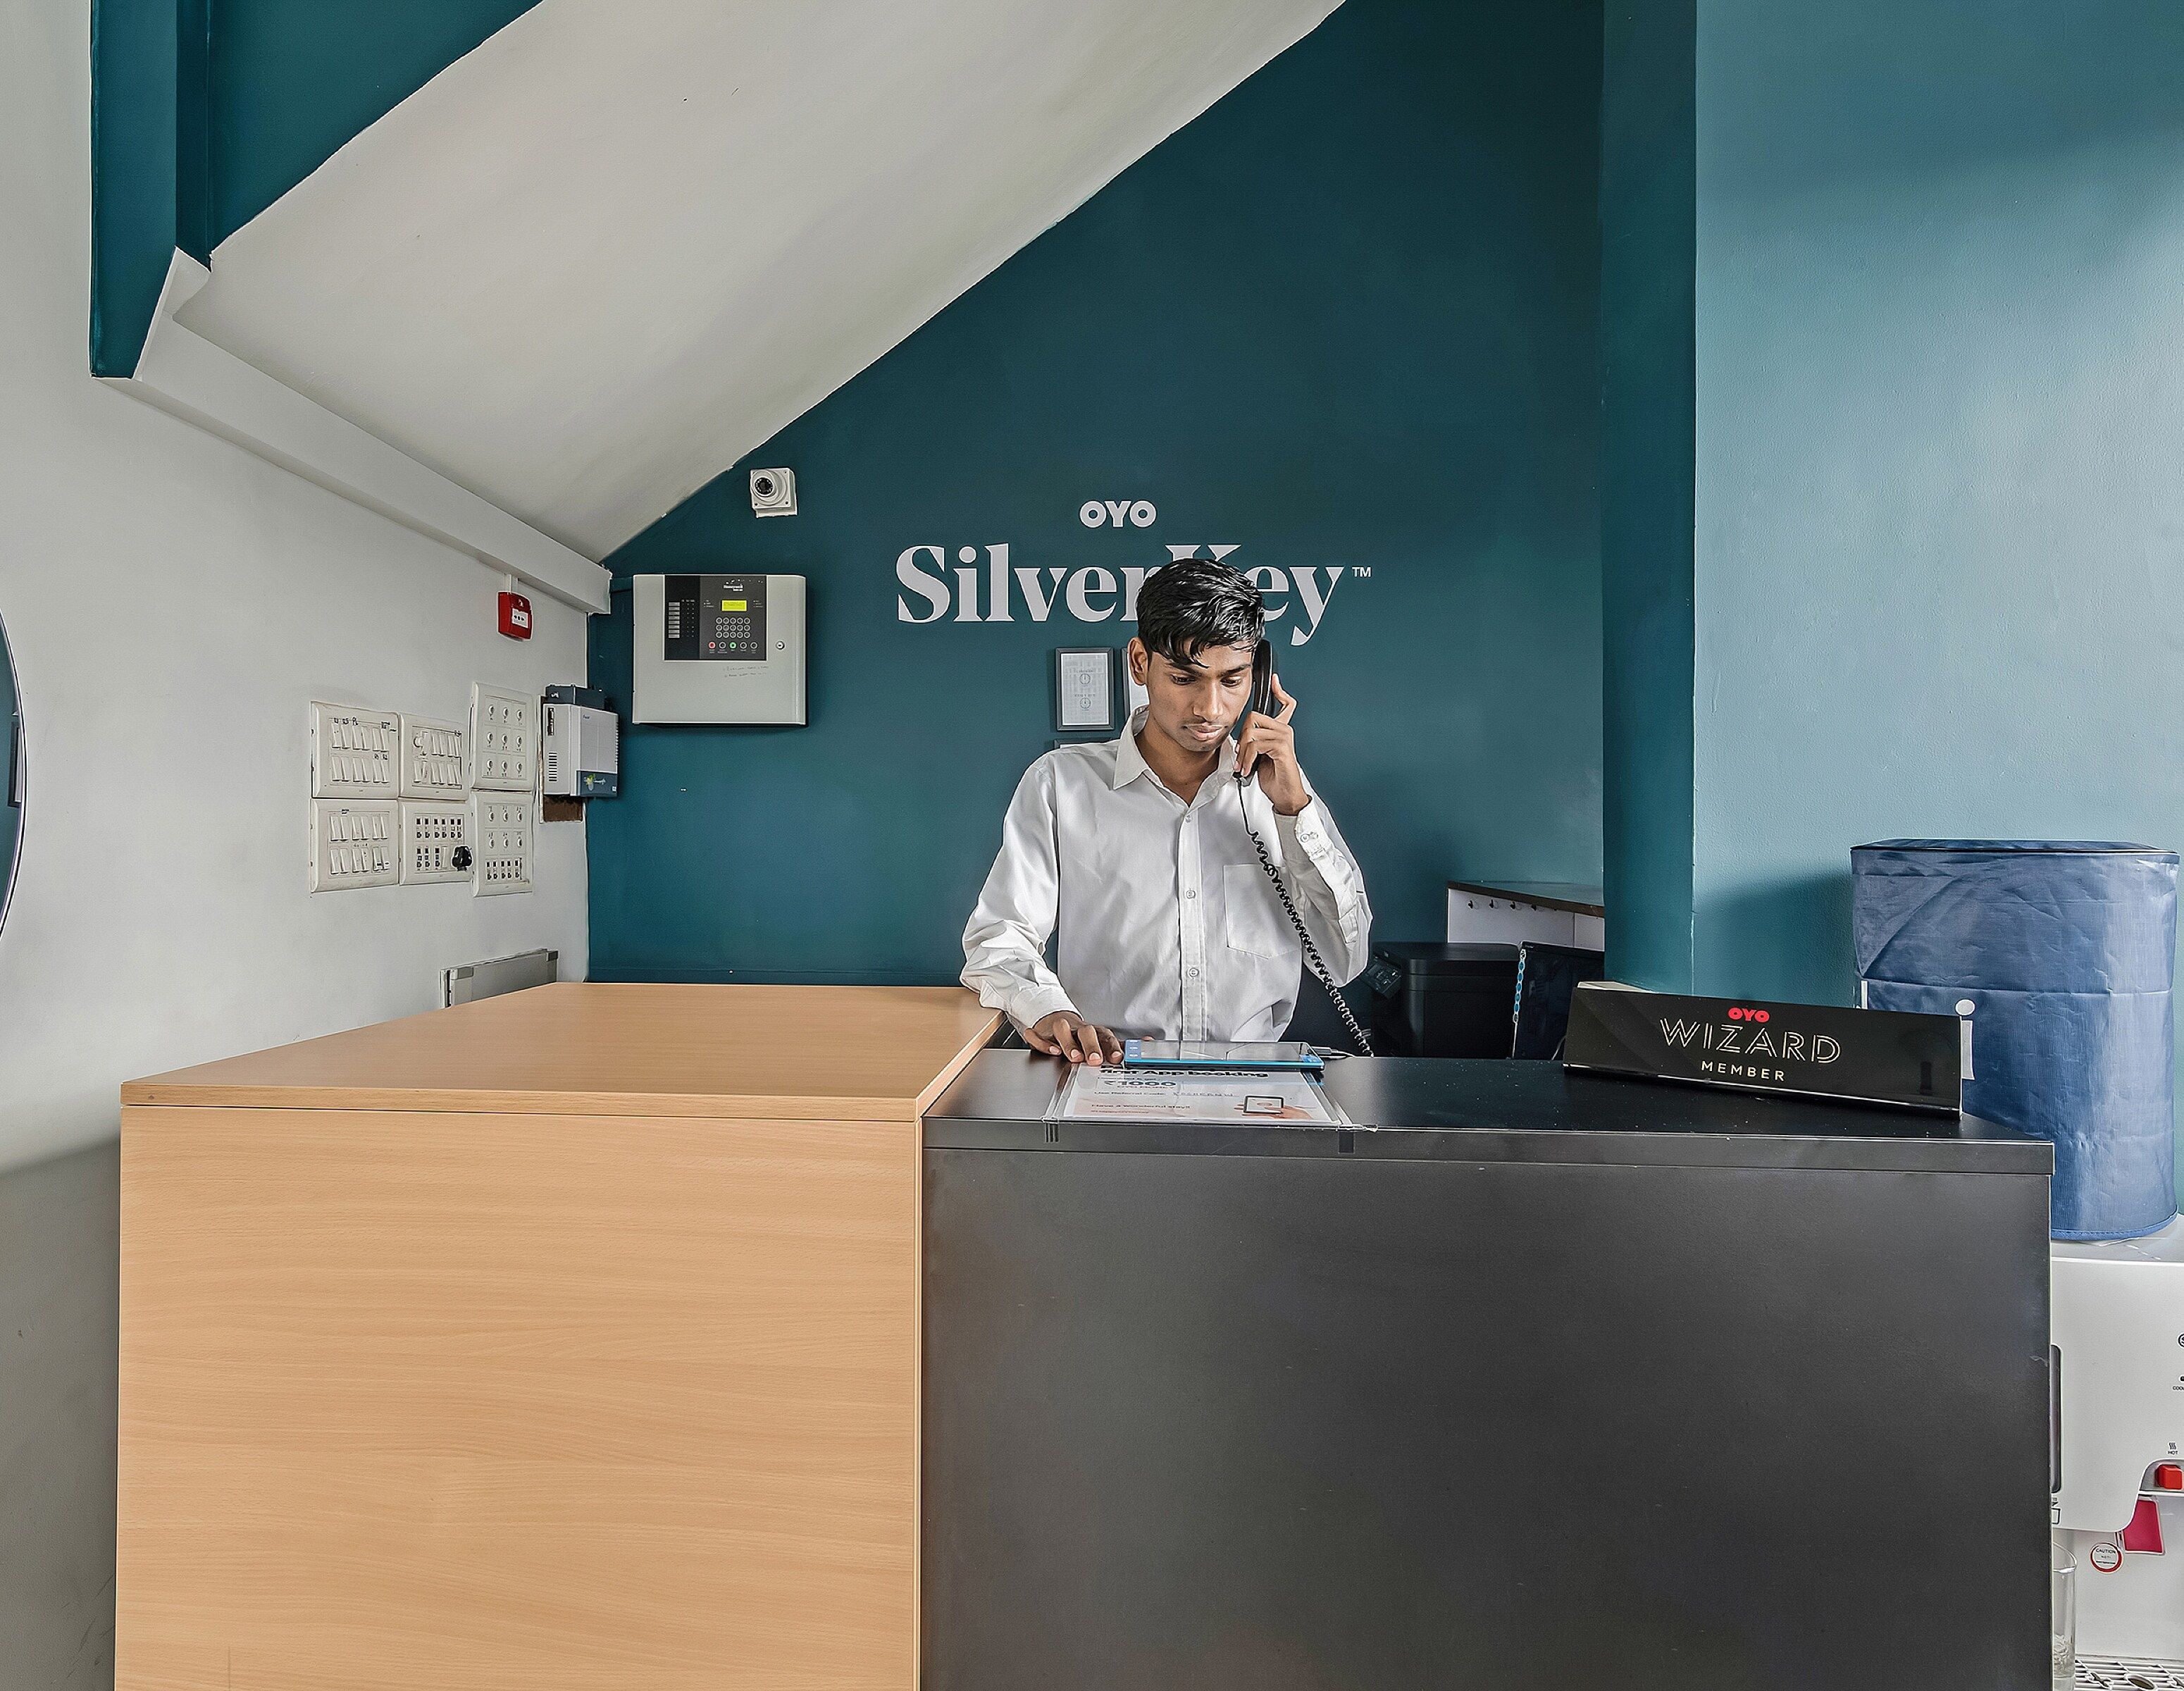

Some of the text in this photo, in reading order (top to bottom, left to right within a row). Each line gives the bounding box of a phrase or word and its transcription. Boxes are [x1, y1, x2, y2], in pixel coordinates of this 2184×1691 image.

[1079, 500, 1157, 528] OYO
[1728, 1007, 1770, 1023] OYO
[1659, 1017, 1841, 1064] WIZARD
[1701, 1060, 1786, 1082] MEMBER
